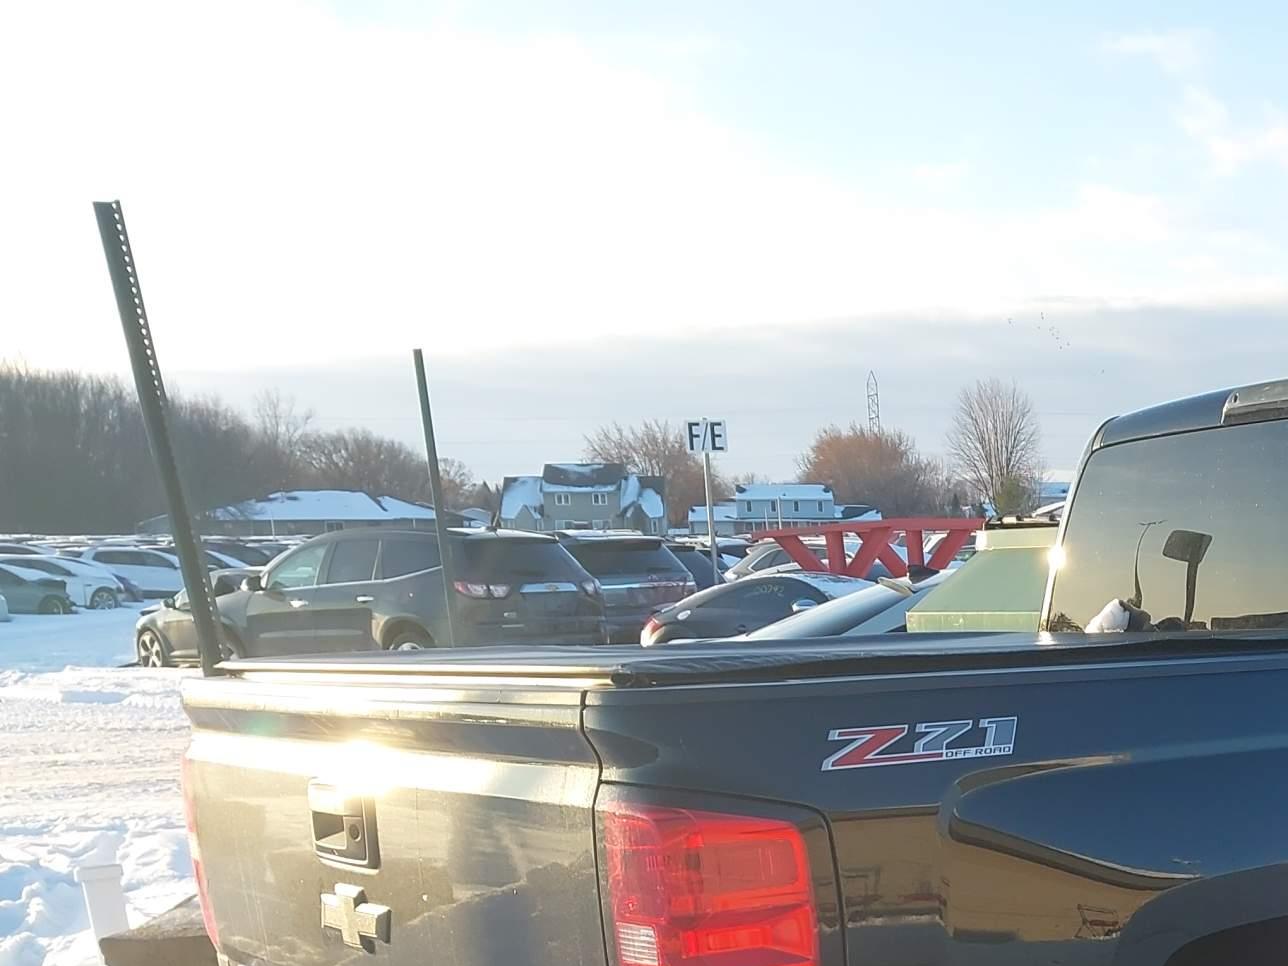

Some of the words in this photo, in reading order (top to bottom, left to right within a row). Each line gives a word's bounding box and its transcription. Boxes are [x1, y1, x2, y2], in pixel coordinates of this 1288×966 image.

[687, 421, 725, 451] F/E
[821, 716, 1018, 771] Z71
[945, 748, 972, 759] OFF
[976, 745, 1012, 756] ROAD
